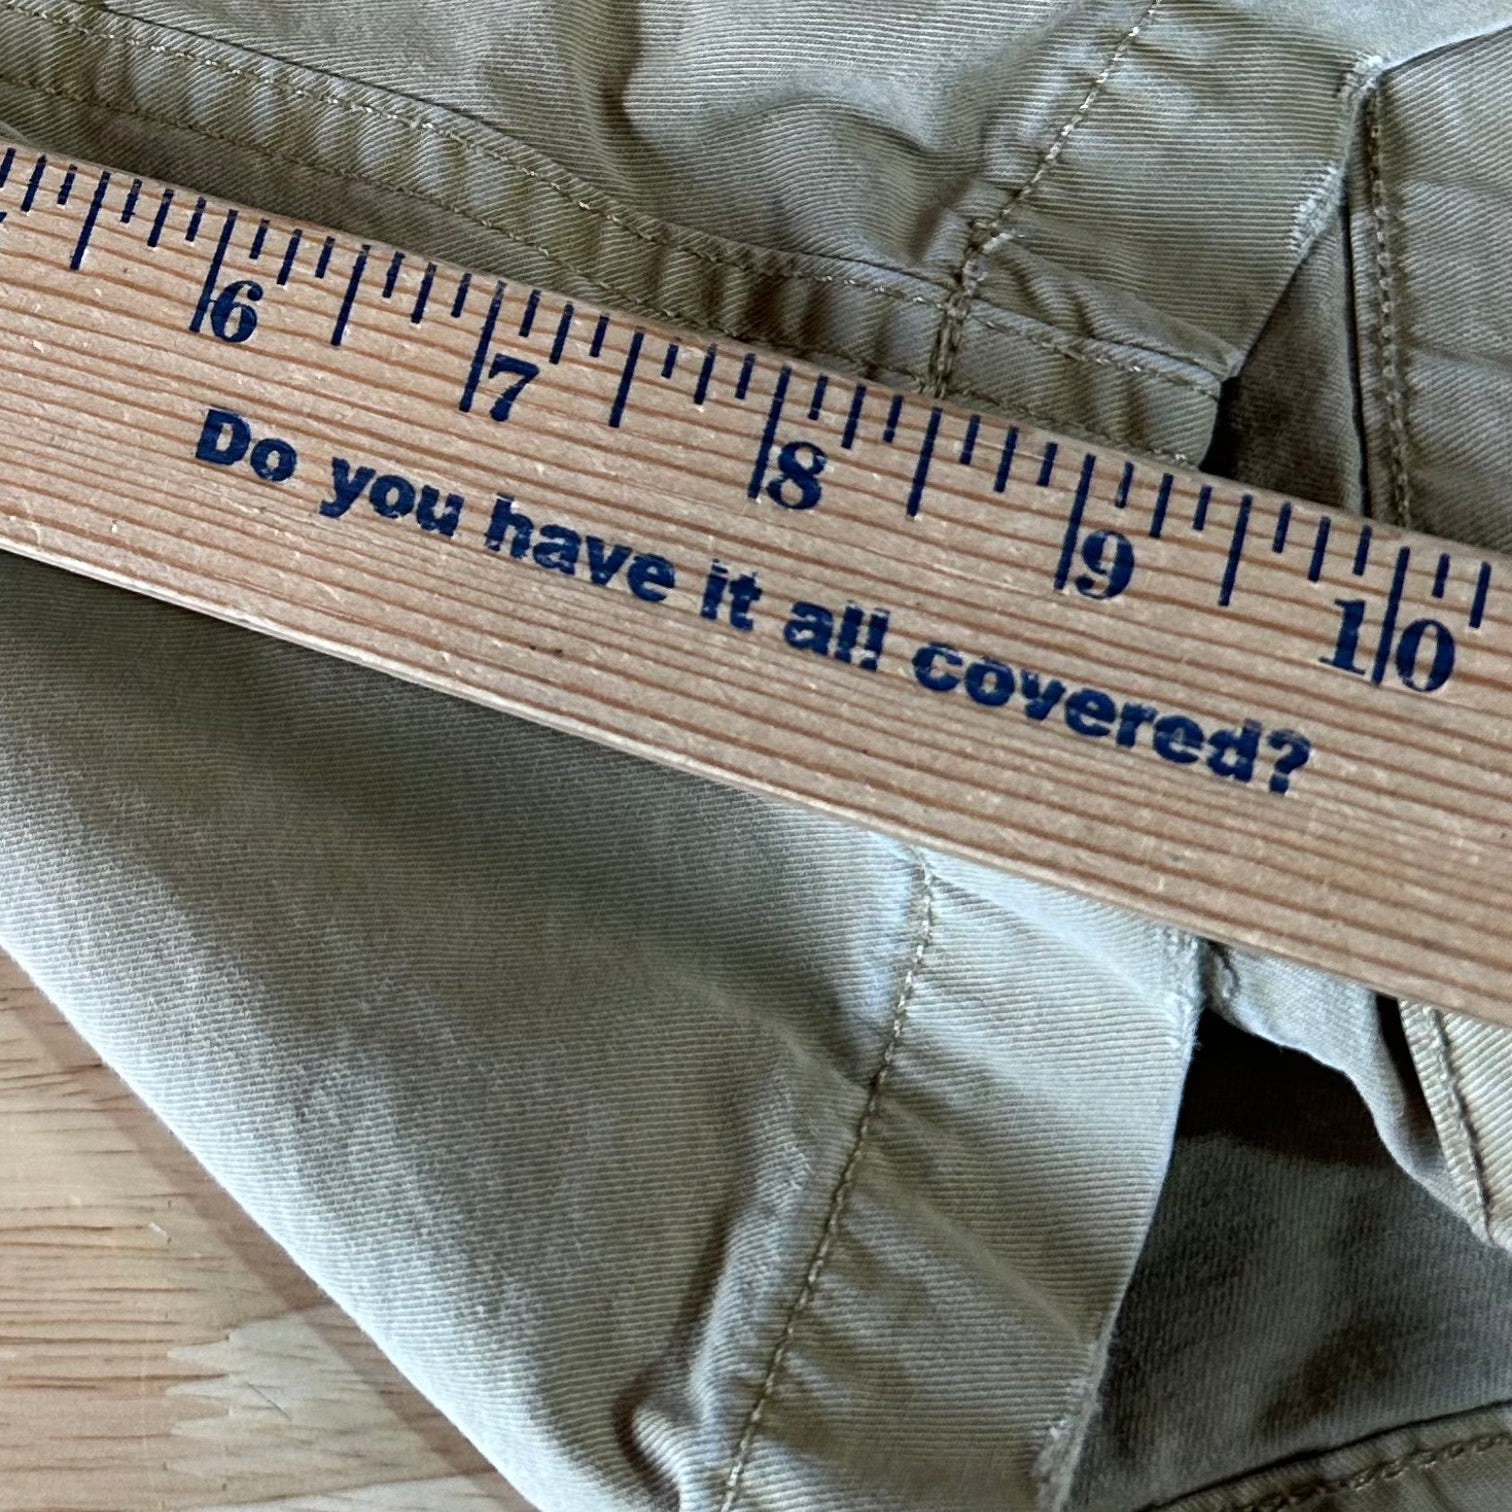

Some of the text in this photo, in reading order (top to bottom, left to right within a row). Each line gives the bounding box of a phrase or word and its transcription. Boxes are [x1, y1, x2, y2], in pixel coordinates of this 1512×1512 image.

[195, 407, 1312, 796] Do you have it all covered?
[210, 280, 263, 343] 6
[488, 353, 539, 423] 7
[767, 440, 827, 511] 8
[1074, 530, 1136, 599] 9
[1318, 597, 1456, 693] 10
